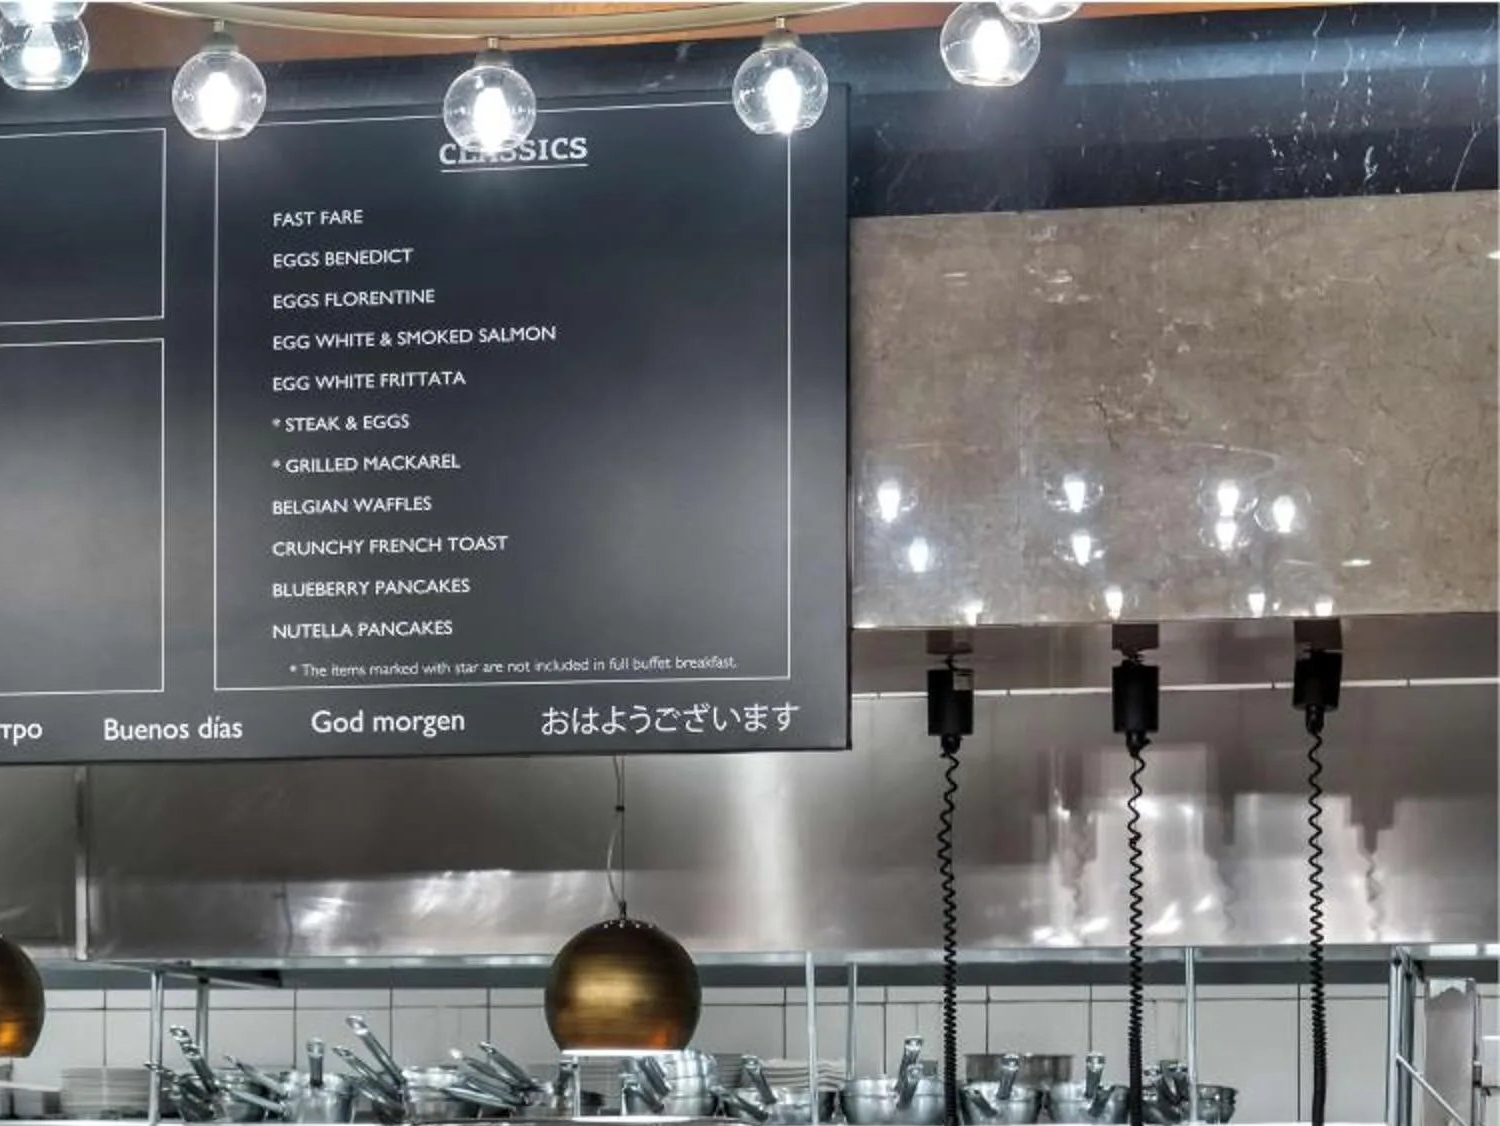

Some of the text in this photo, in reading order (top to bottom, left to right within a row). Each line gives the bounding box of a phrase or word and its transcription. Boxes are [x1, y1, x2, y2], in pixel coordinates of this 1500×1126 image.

[273, 209, 364, 228] FAST FARE
[273, 247, 414, 269] EGGS BENEDICT
[272, 288, 436, 310] EGGS FLORENTINE
[272, 325, 557, 351] EGG WHITE SMOKED SALMON
[272, 370, 467, 392] EGG WHITE FRITTATA
[284, 413, 410, 433] STEAK EGGS
[285, 453, 461, 474] GRILLED MACKAREL
[272, 495, 433, 515] BELGIAN WAFFLES
[272, 535, 509, 557] CRUNCHY FRENCH TOAST
[272, 577, 471, 598] BLUEBERRY PANCAKES
[272, 619, 453, 639] NUTELLA PANCAKES
[301, 663, 328, 677] The
[331, 663, 367, 677] items
[369, 661, 419, 676] marked
[421, 661, 451, 675] with
[454, 662, 480, 675] star
[482, 663, 504, 673] are
[507, 661, 531, 673] not
[534, 657, 590, 673] included
[593, 657, 606, 671] in
[608, 657, 629, 671] full
[632, 655, 672, 671] buffet
[103, 715, 243, 741] Buenos días
[311, 709, 465, 738] God morgen
[541, 701, 800, 736] おはようございます
